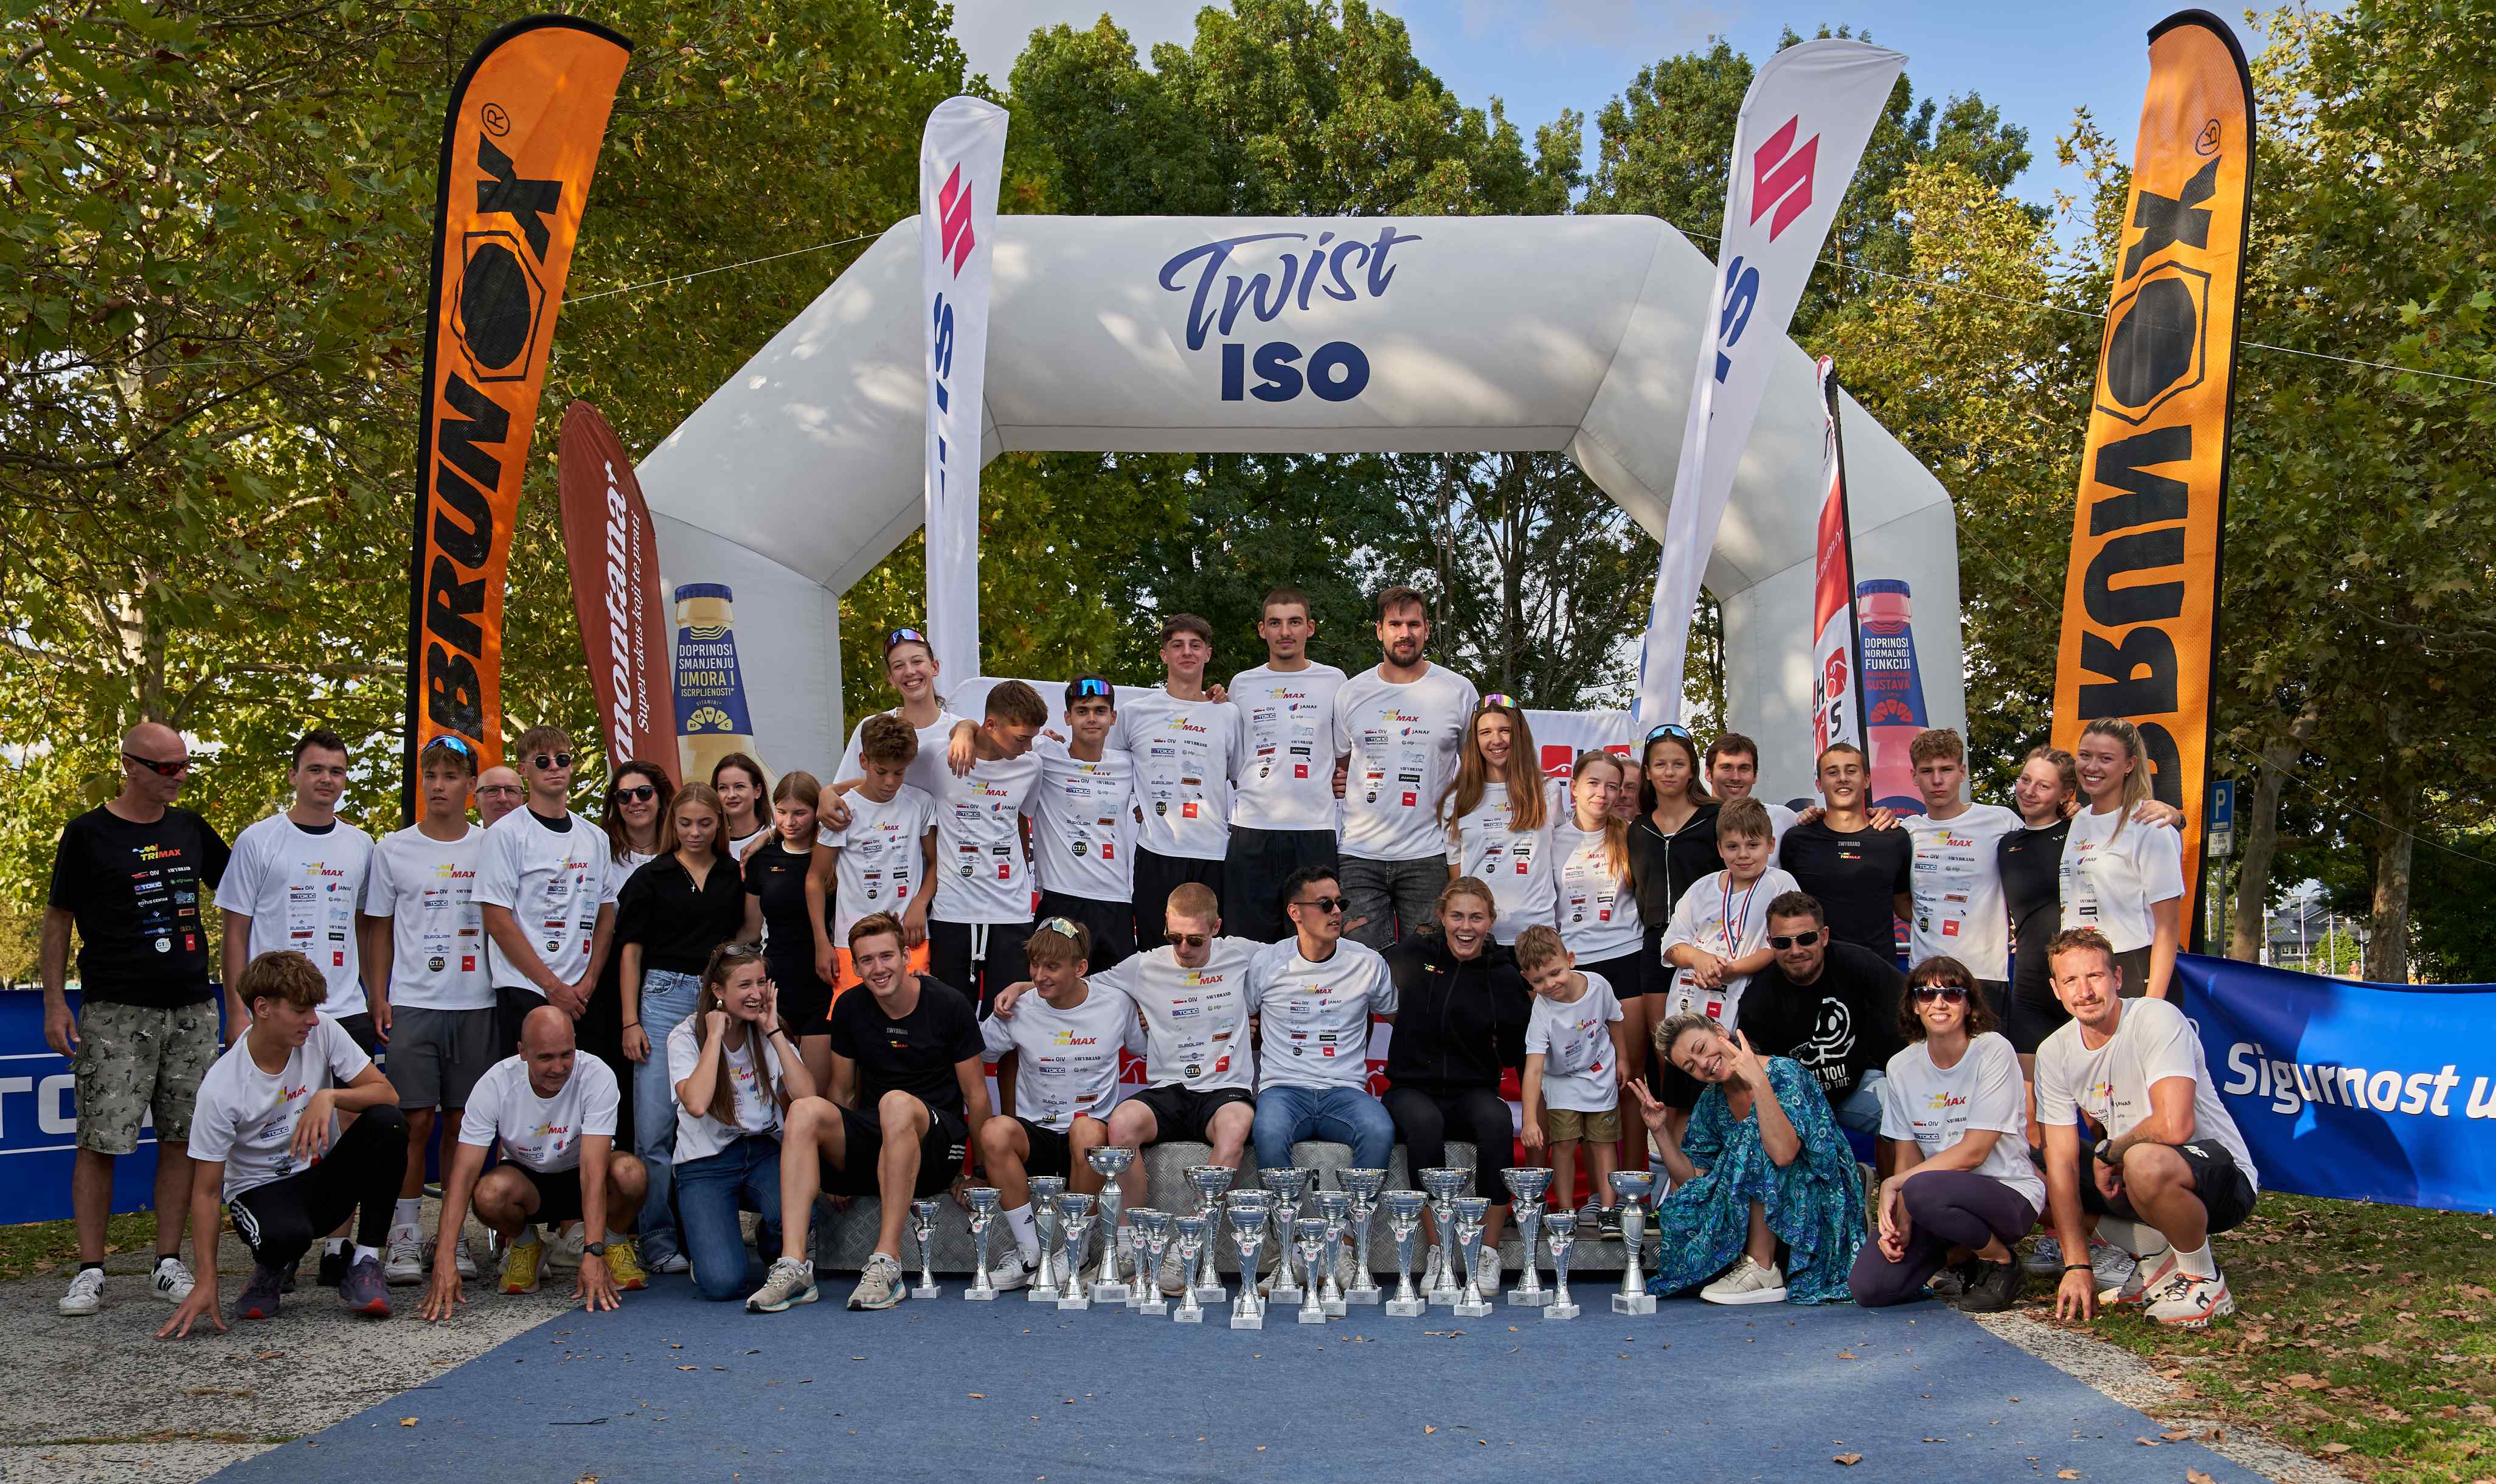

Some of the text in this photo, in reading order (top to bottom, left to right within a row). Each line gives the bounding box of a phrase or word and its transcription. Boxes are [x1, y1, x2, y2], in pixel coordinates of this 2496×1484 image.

[1159, 226, 1423, 351] Twist
[1221, 341, 1370, 402] ISO
[605, 485, 634, 763] montana
[631, 510, 651, 733] Super okus koji te prati
[1865, 637, 1908, 648] DOPRINOSI
[679, 643, 733, 656] DOPRINOSI
[1865, 648, 1909, 657] NORMALNOJ
[679, 657, 734, 669] SMANJENJU
[1865, 659, 1910, 670] FUNKCIJI
[680, 670, 735, 687] UMORA I
[1866, 679, 1910, 691] SUSTAVA
[1168, 724, 1207, 733] TRIMAX
[2215, 788, 2226, 819] P
[140, 849, 181, 861] TRIMAX
[1822, 1064, 1846, 1081] YOU
[2223, 1042, 2461, 1116] Sigurnost
[1928, 1097, 1966, 1109] TRIMAX
[277, 1114, 286, 1123] OIV
